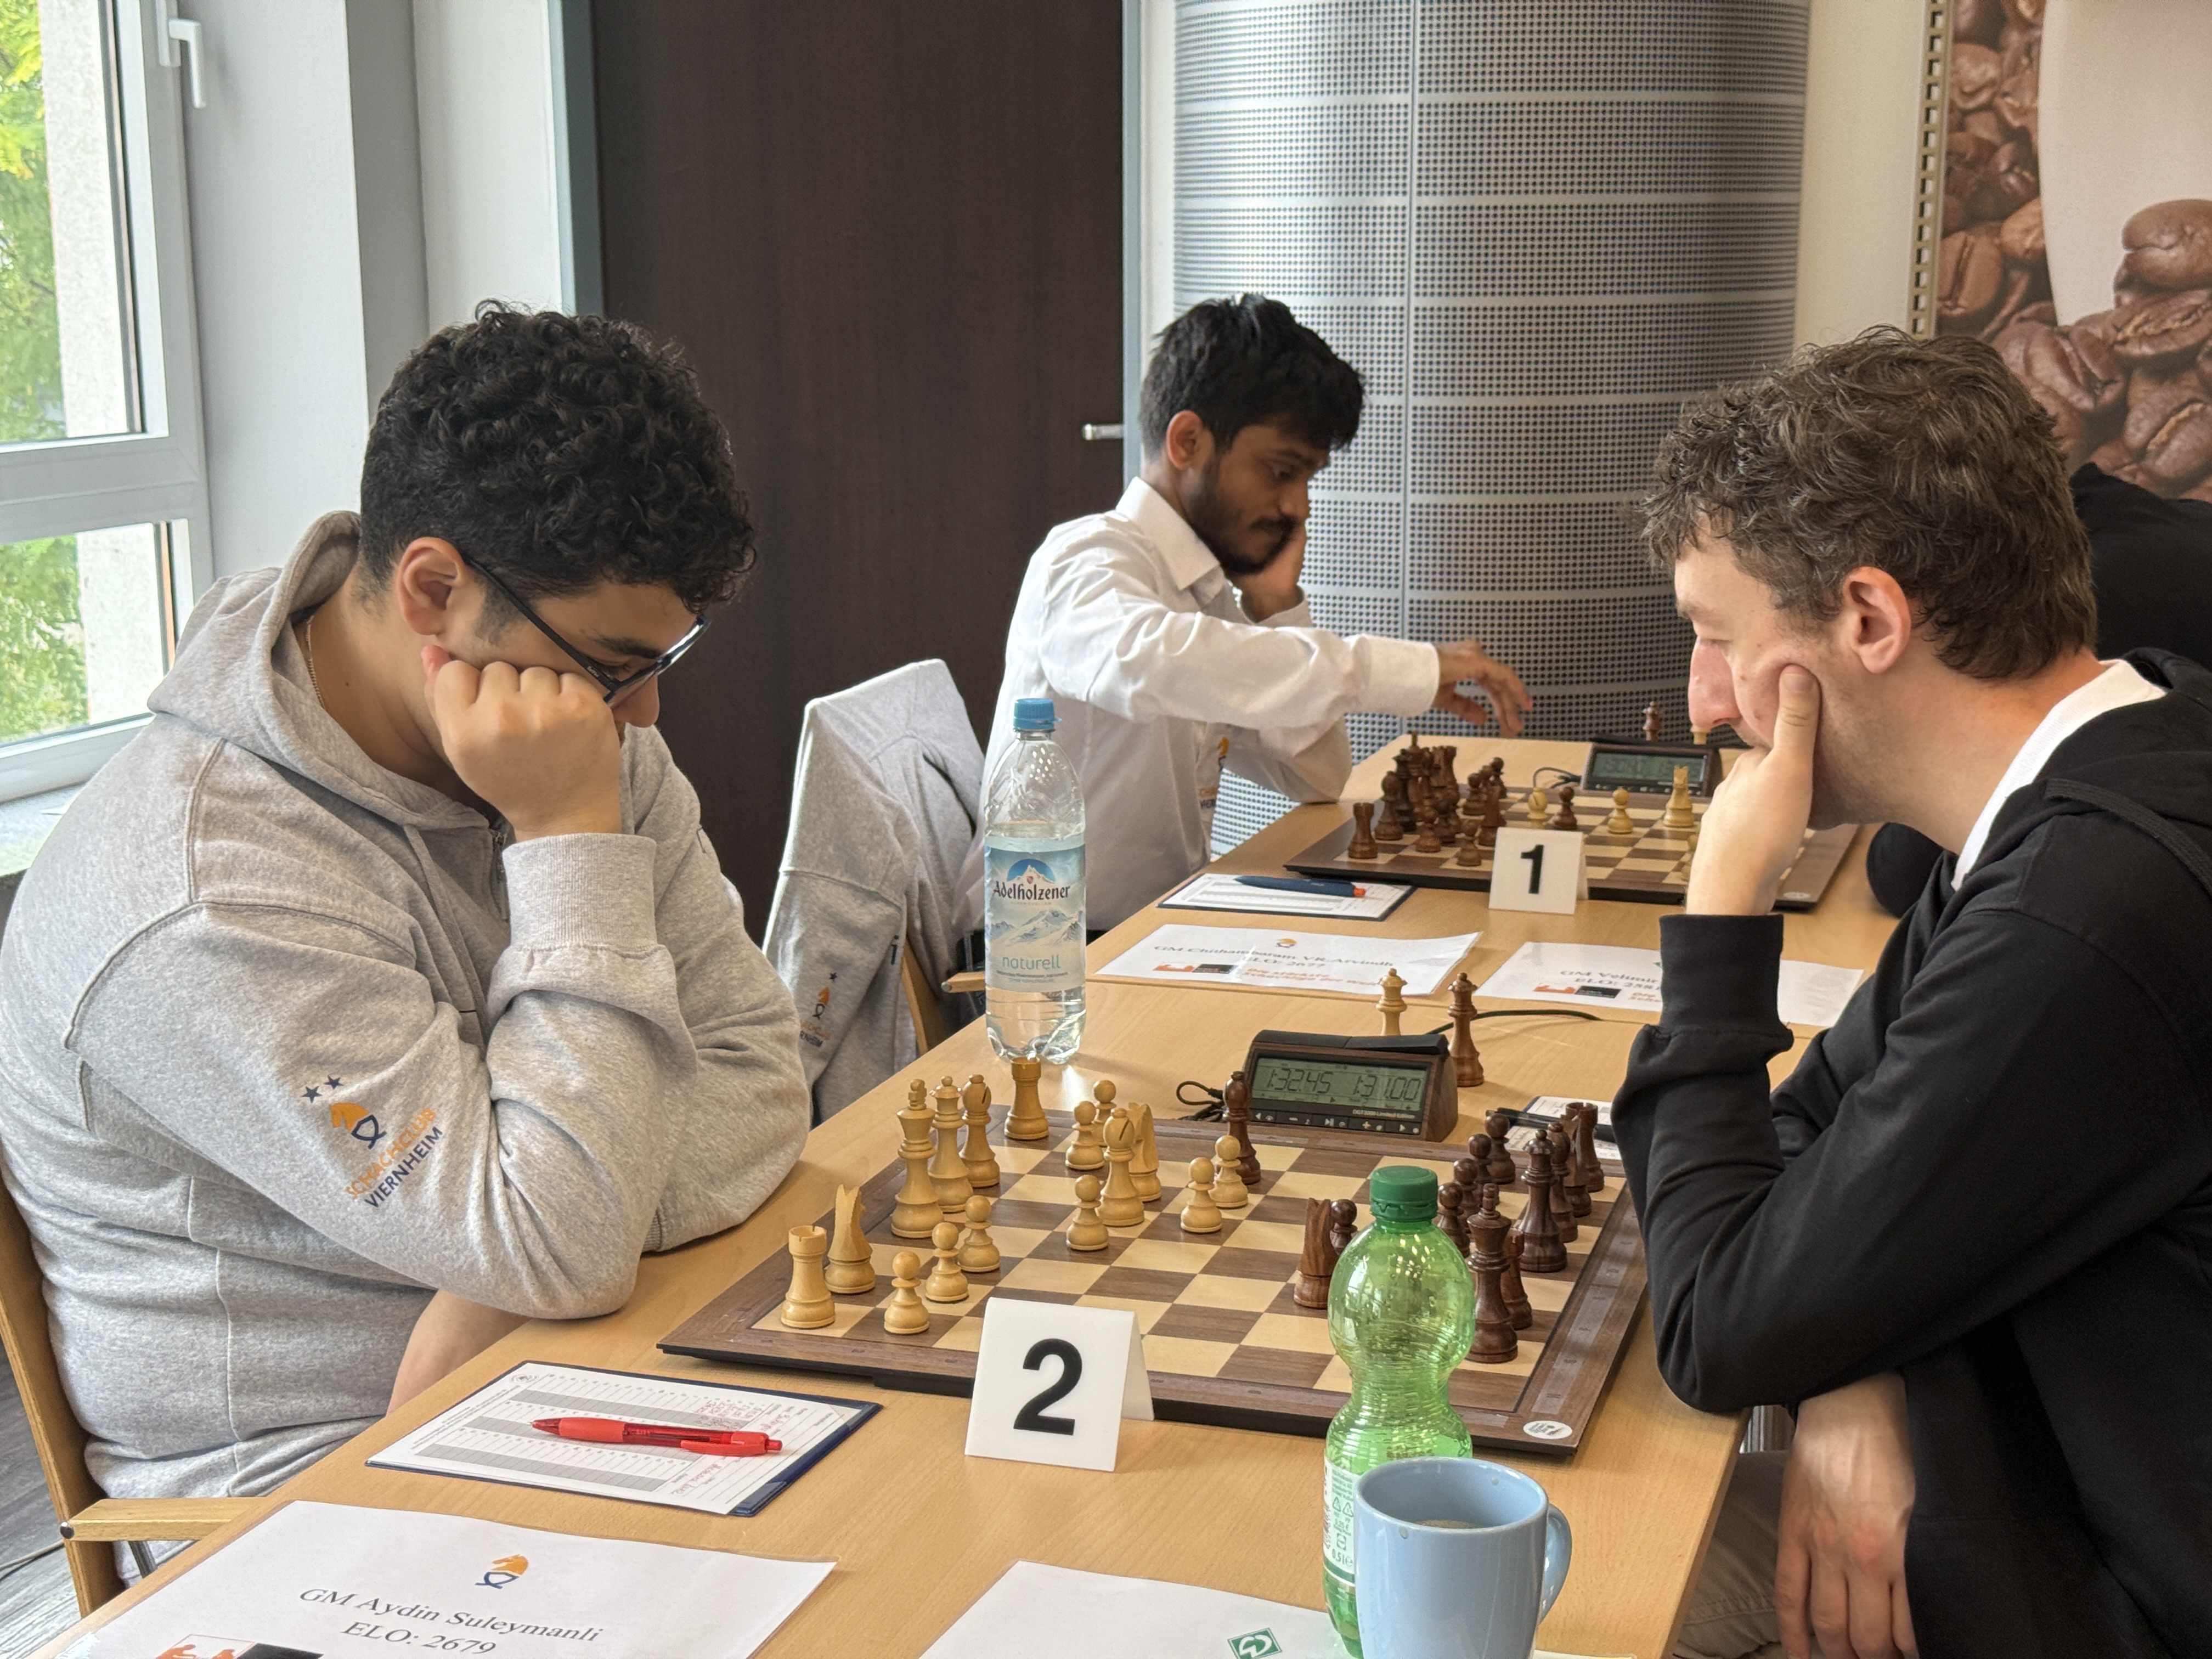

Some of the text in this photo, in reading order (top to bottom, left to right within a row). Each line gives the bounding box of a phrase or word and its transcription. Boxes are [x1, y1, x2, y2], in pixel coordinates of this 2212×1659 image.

[994, 881, 1070, 900] Adelholzener
[1521, 845, 1544, 894] 1
[1002, 955, 1060, 970] naturell
[345, 1108, 437, 1199] SCHACHCLUB
[364, 1126, 443, 1207] VIERNHEIM
[1013, 1338, 1082, 1436] 2
[300, 1589, 603, 1641] GM Aydin Suleymanli
[340, 1621, 496, 1654] ELO: 2679
